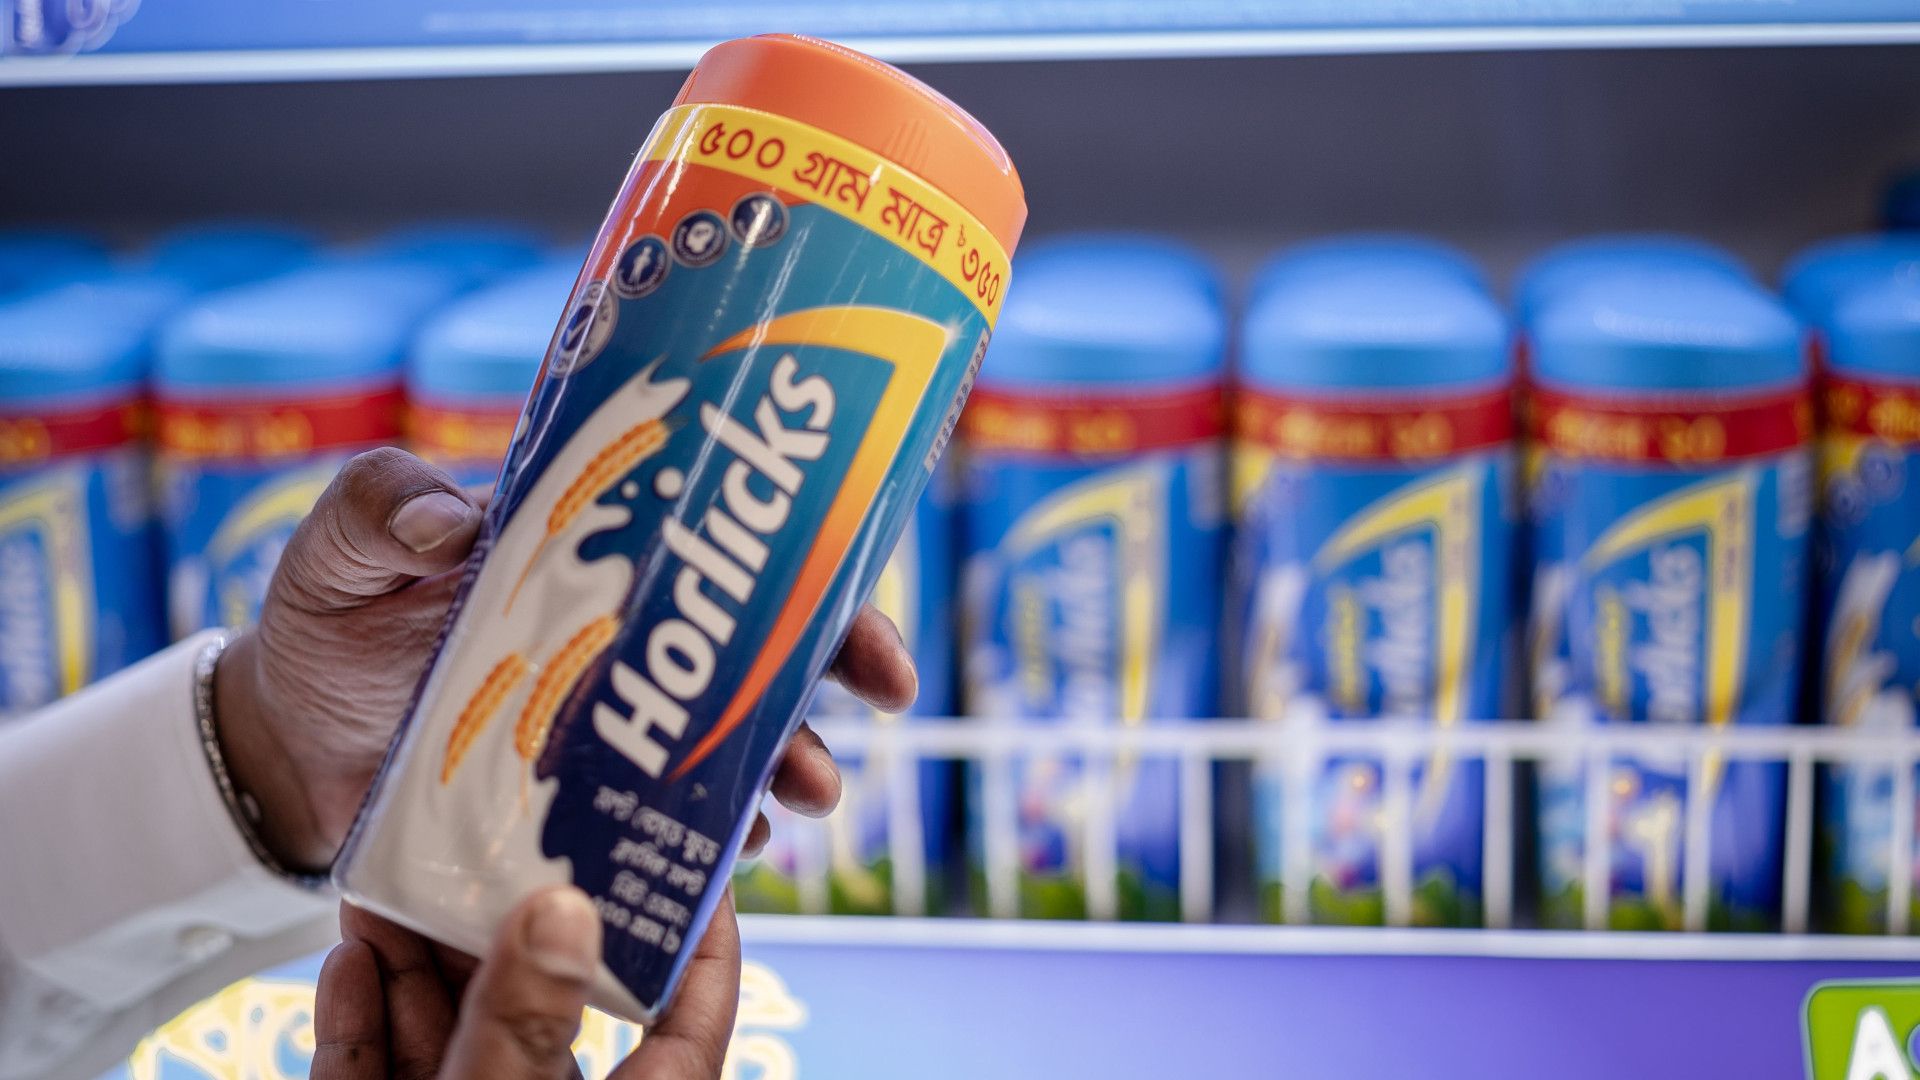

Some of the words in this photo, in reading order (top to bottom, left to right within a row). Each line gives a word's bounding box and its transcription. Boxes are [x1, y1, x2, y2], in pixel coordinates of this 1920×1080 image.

[699, 122, 785, 169] ৫০০
[793, 152, 877, 213] গ্রাম
[881, 187, 949, 259] মাত্র
[591, 353, 838, 780] Horlicks
